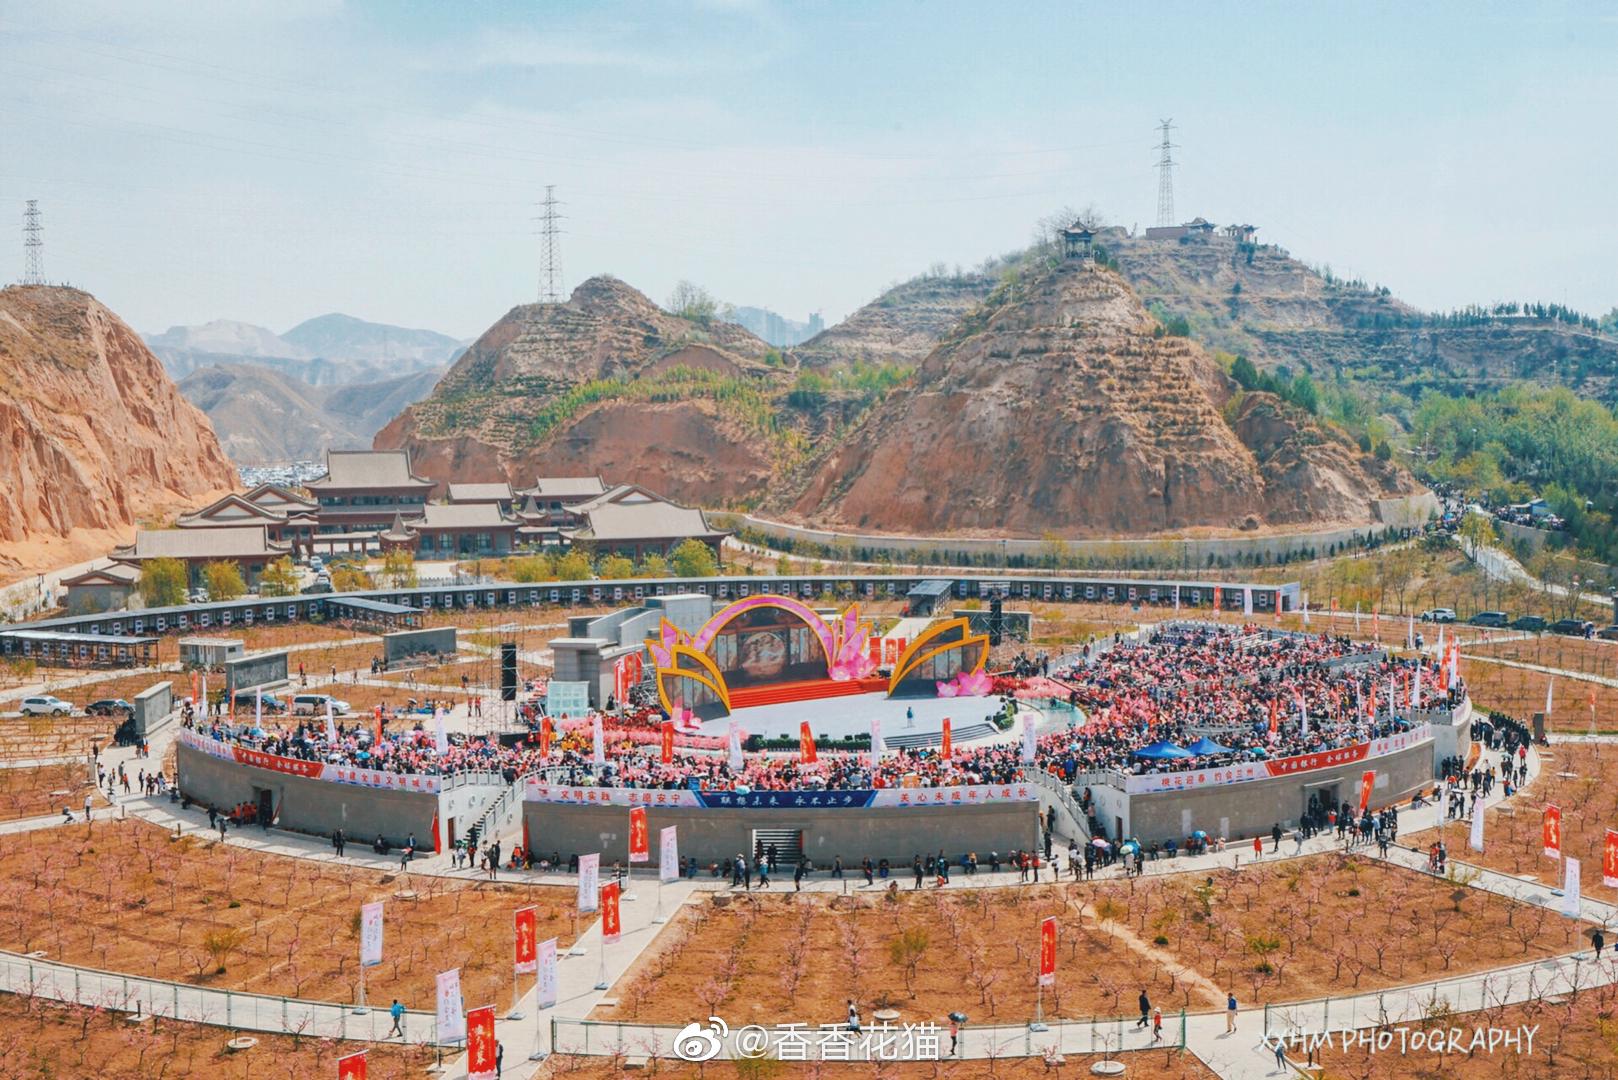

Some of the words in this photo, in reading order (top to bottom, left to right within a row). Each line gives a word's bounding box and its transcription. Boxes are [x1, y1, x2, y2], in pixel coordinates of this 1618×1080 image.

[1280, 757, 1318, 772] 中国银行
[336, 769, 433, 789] 创建全国文明城市
[1161, 773, 1206, 787] 桃花迎春
[1213, 767, 1254, 781] 约会兰州
[560, 790, 611, 801] 文明实践
[628, 792, 681, 804] 志愿安宁
[795, 794, 853, 806] 永不止步
[899, 787, 1029, 802] 关心未成年人成长
